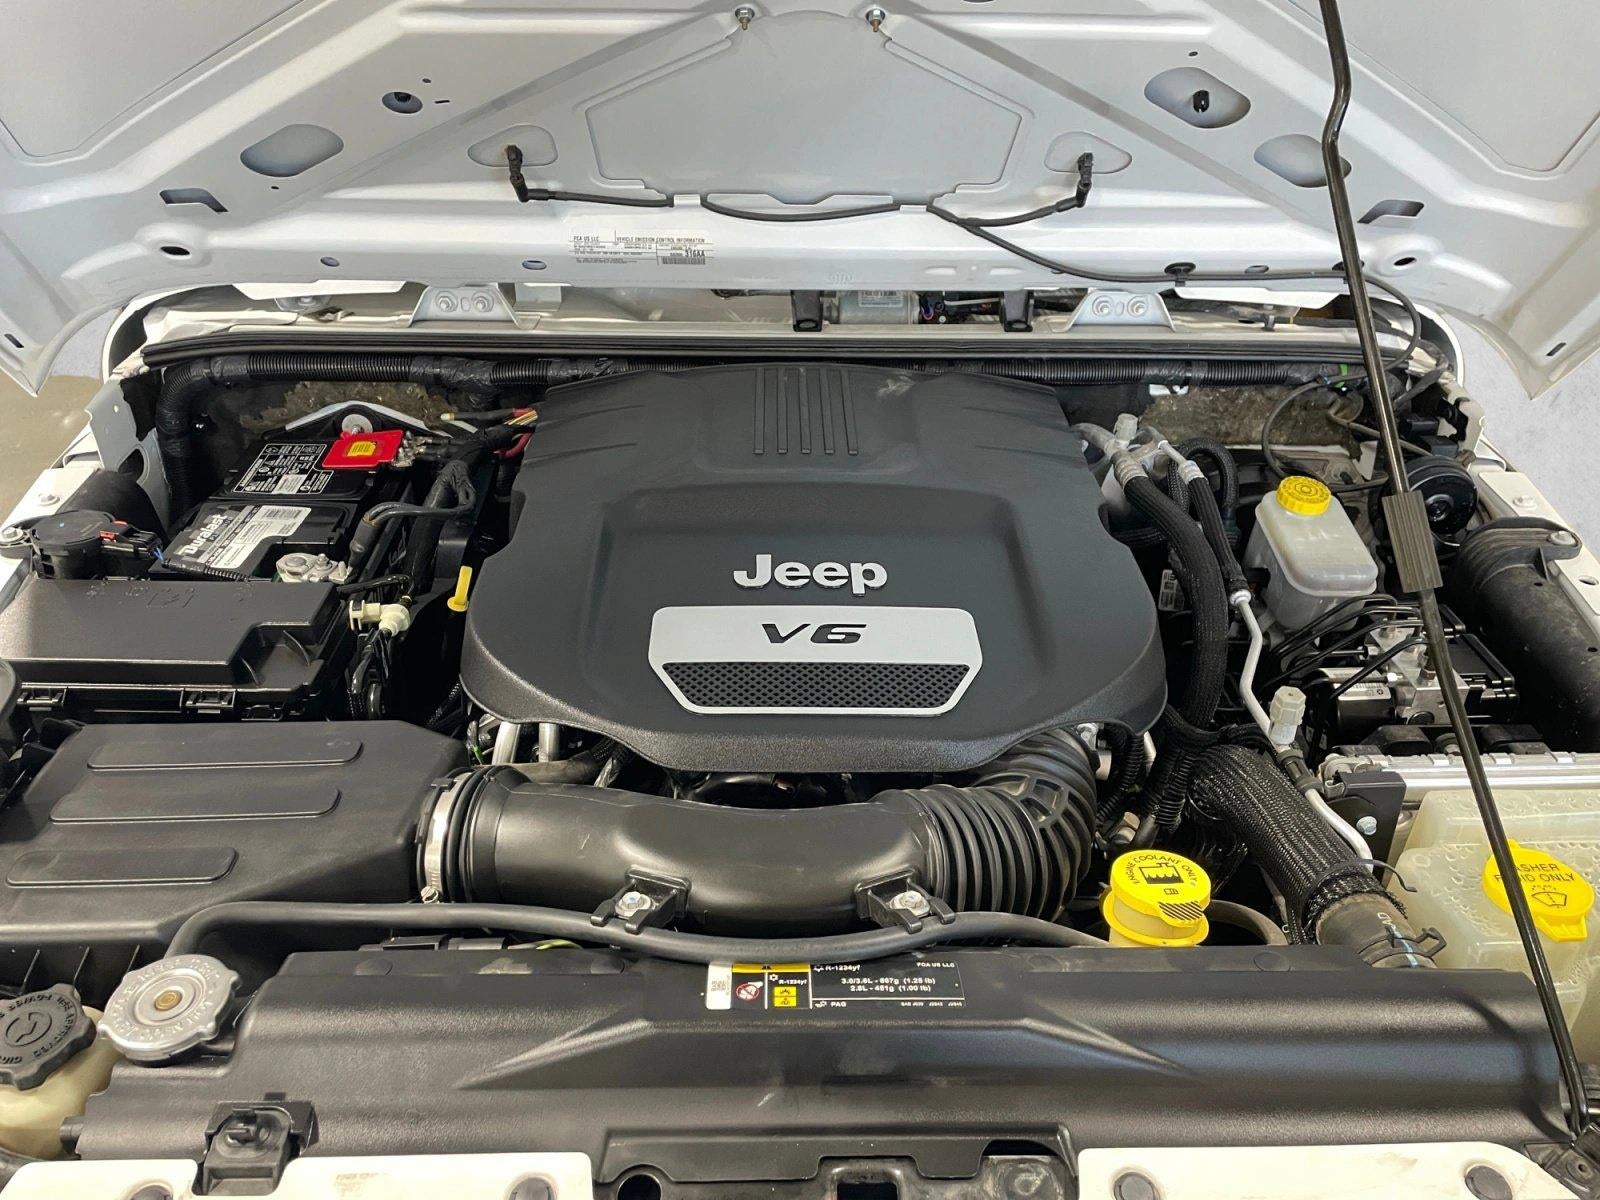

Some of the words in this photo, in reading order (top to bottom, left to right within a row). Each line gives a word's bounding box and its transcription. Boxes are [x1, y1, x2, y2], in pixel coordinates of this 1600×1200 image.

[174, 514, 228, 556] Duralast
[733, 553, 888, 595] Jeep
[761, 623, 867, 644] V6
[1133, 854, 1182, 865] COOLANT
[1514, 863, 1560, 872] SHER
[1494, 873, 1536, 883] FID
[1539, 872, 1575, 882] ONLY
